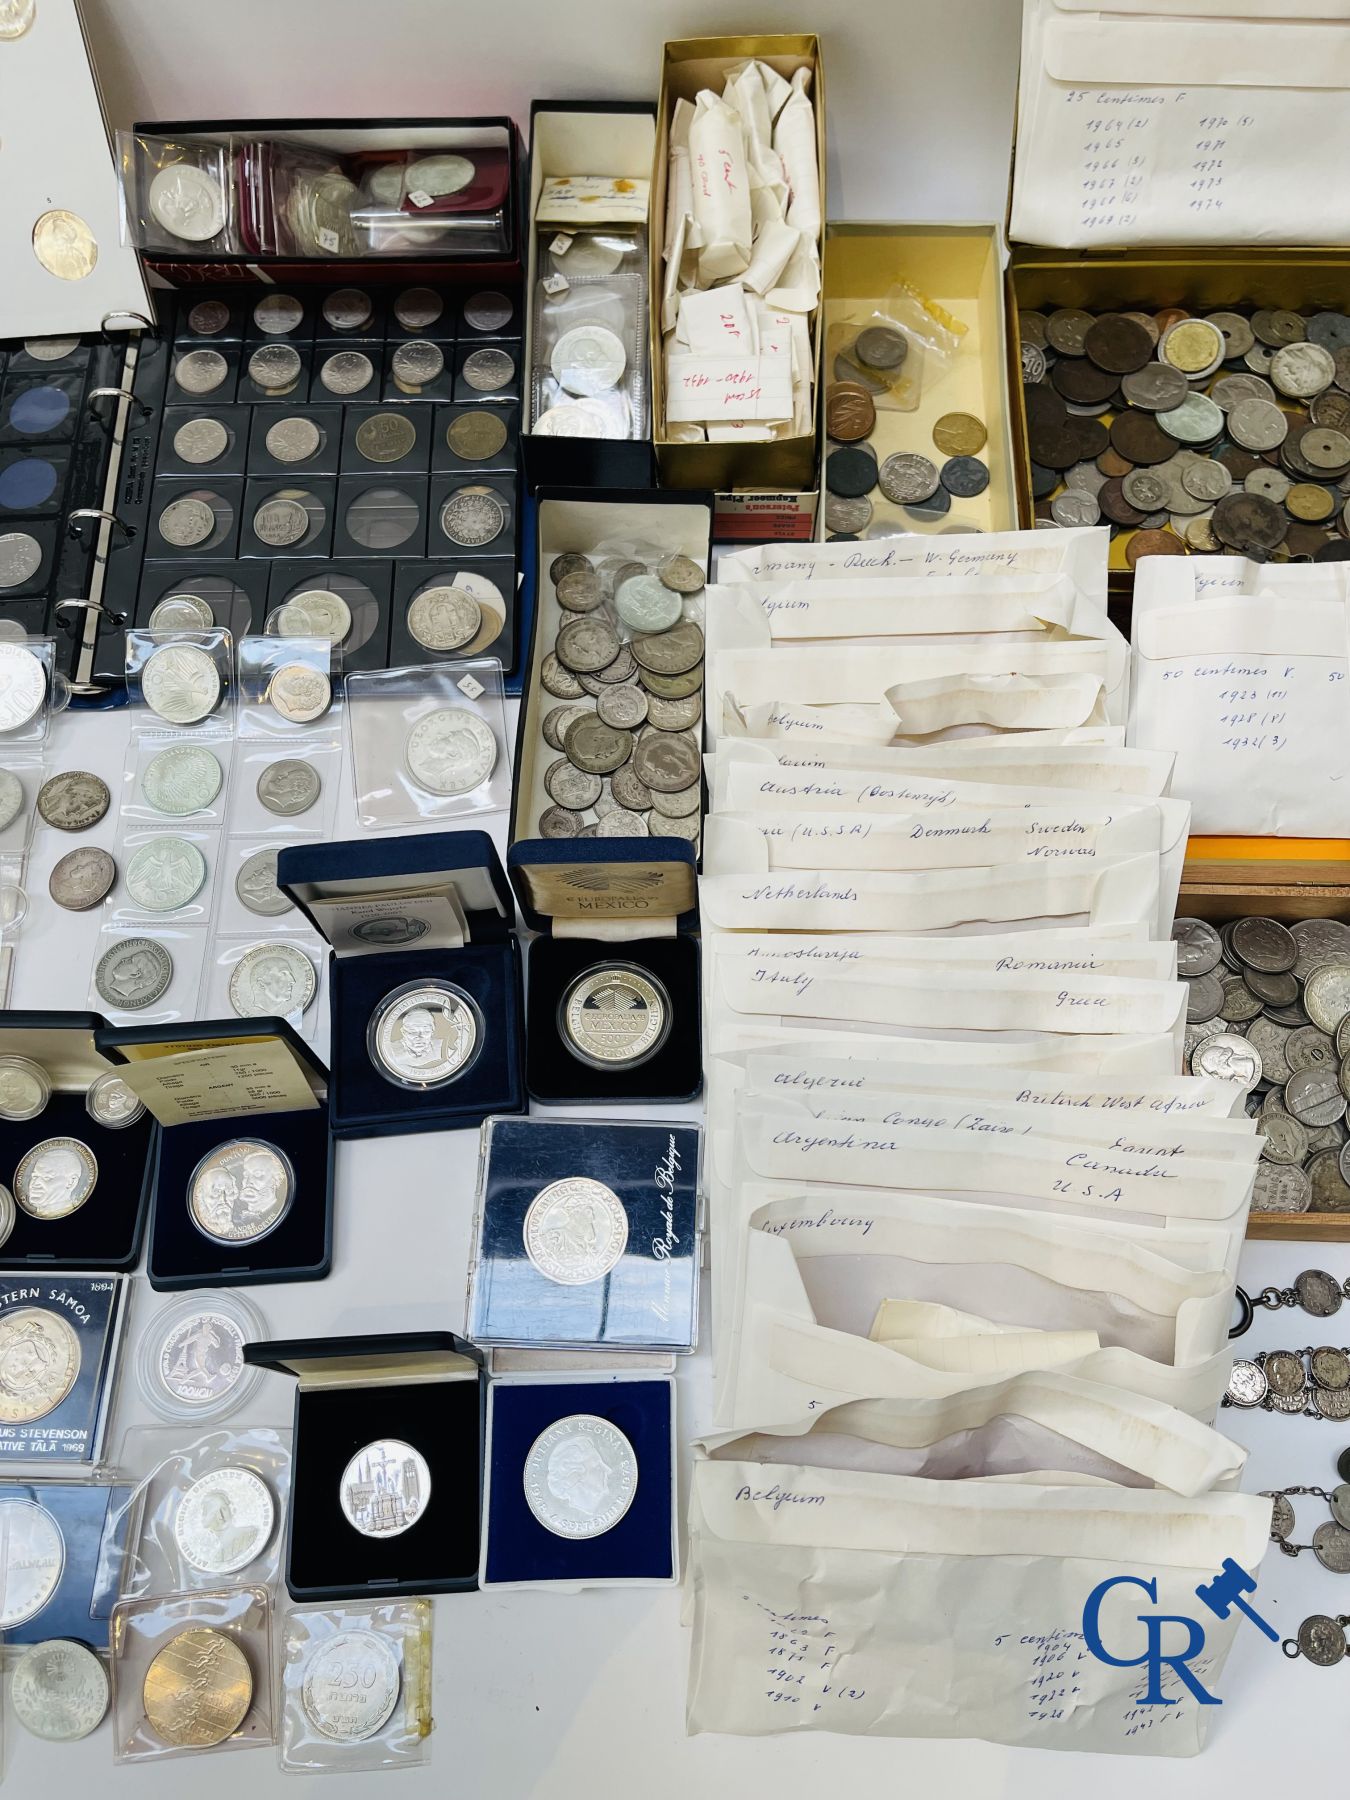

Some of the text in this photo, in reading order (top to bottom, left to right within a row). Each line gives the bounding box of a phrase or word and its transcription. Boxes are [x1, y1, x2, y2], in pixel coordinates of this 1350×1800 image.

[909, 818, 992, 839] Denmark
[742, 882, 858, 901] Netherlands
[579, 901, 650, 910] MEXICO
[752, 968, 815, 996] Italy
[772, 1130, 899, 1152] Argentina
[654, 1133, 682, 1195] Belgique
[660, 1193, 674, 1211] de
[652, 1211, 680, 1265] Royale
[49, 1289, 91, 1325] SAMOA
[20, 1428, 88, 1440] STEVENSON
[735, 1484, 825, 1510] Belgium
[328, 1660, 378, 1690] 250
[838, 1686, 866, 1700] (2)
